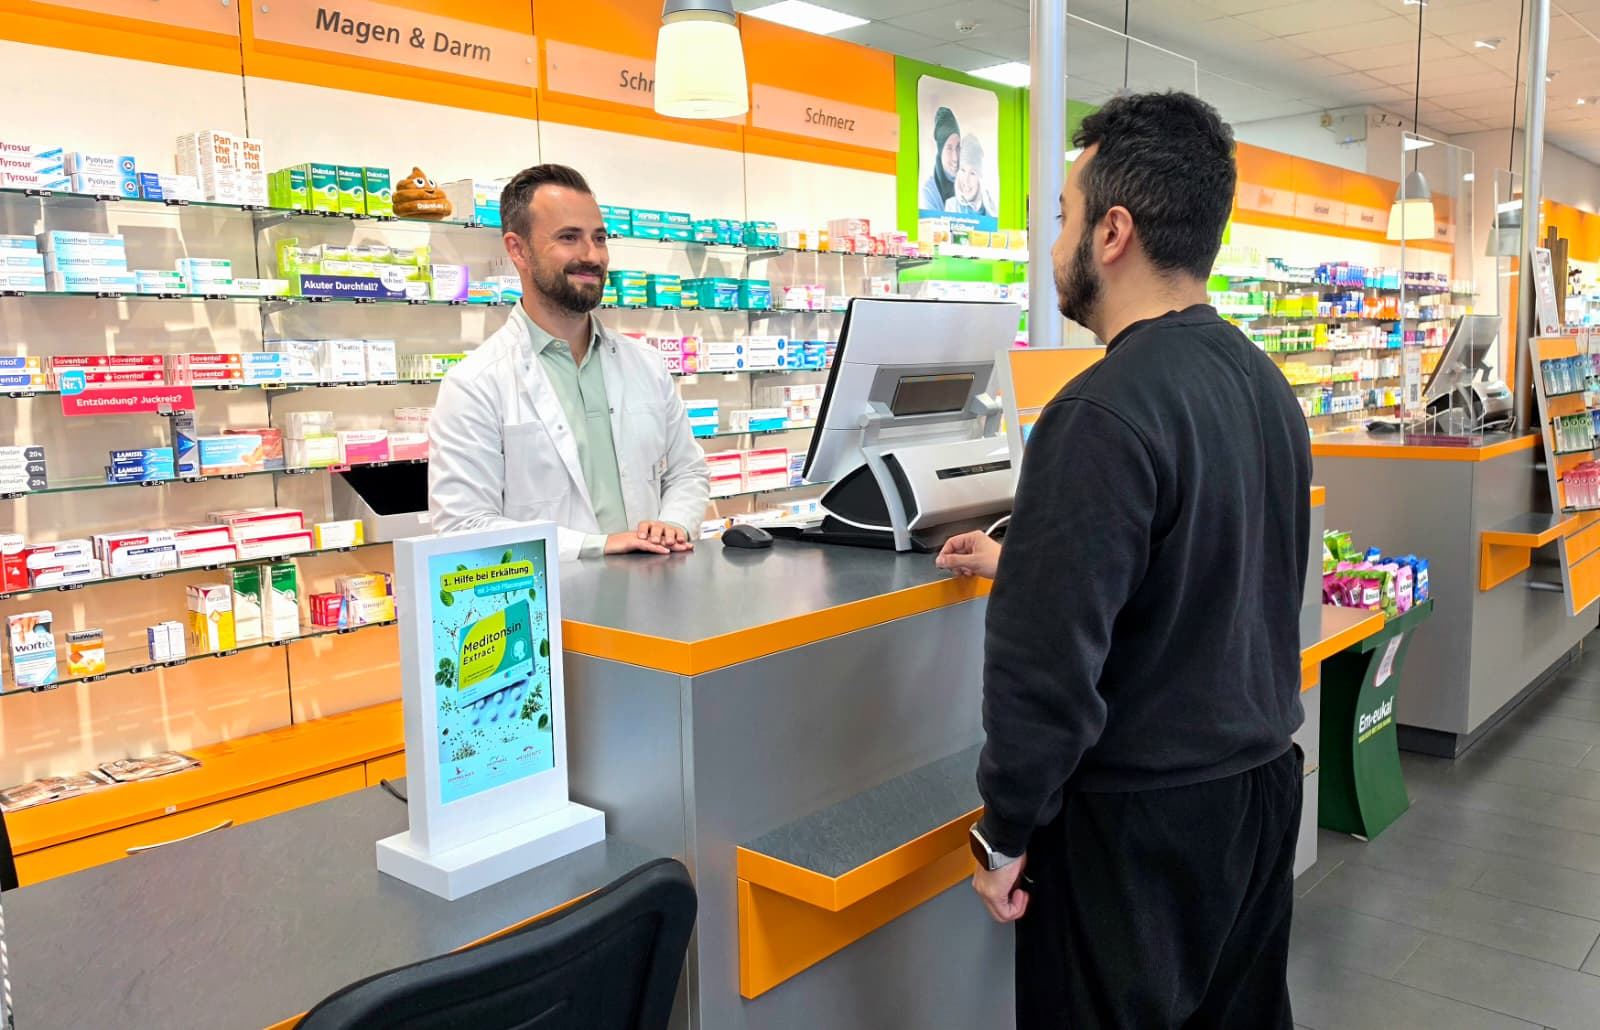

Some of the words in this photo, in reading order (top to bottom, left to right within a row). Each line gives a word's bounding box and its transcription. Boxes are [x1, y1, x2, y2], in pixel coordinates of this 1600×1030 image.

[315, 8, 399, 44] Magen
[409, 27, 426, 49] &
[433, 31, 491, 62] Darm
[805, 107, 855, 131] Schmerz
[213, 134, 231, 145] Pan
[0, 142, 31, 152] Tyrosur
[214, 145, 230, 154] the
[243, 141, 261, 152] Pan
[215, 155, 230, 164] nol
[244, 152, 260, 161] the
[0, 158, 31, 168] Tyrosur
[245, 161, 260, 170] nol
[6, 172, 38, 182] Tyrosur
[304, 280, 333, 290] Akuter
[335, 281, 378, 291] Durchfall?
[54, 357, 88, 365] Soventol
[111, 356, 144, 365] Soventol
[190, 355, 222, 363] Soventol
[193, 370, 225, 378] Soventol
[63, 381, 76, 390] Nr.
[76, 395, 138, 408] Entzündung?
[141, 394, 182, 405] Juckreiz?
[444, 579, 452, 587] 1.
[454, 575, 474, 585] Hilfe
[476, 571, 489, 581] bei
[491, 566, 529, 578] Erkältung
[463, 622, 522, 655] Meditonsin
[15, 641, 53, 653] wortie
[463, 645, 496, 666] Extract
[1359, 696, 1393, 734] Em-eukal
